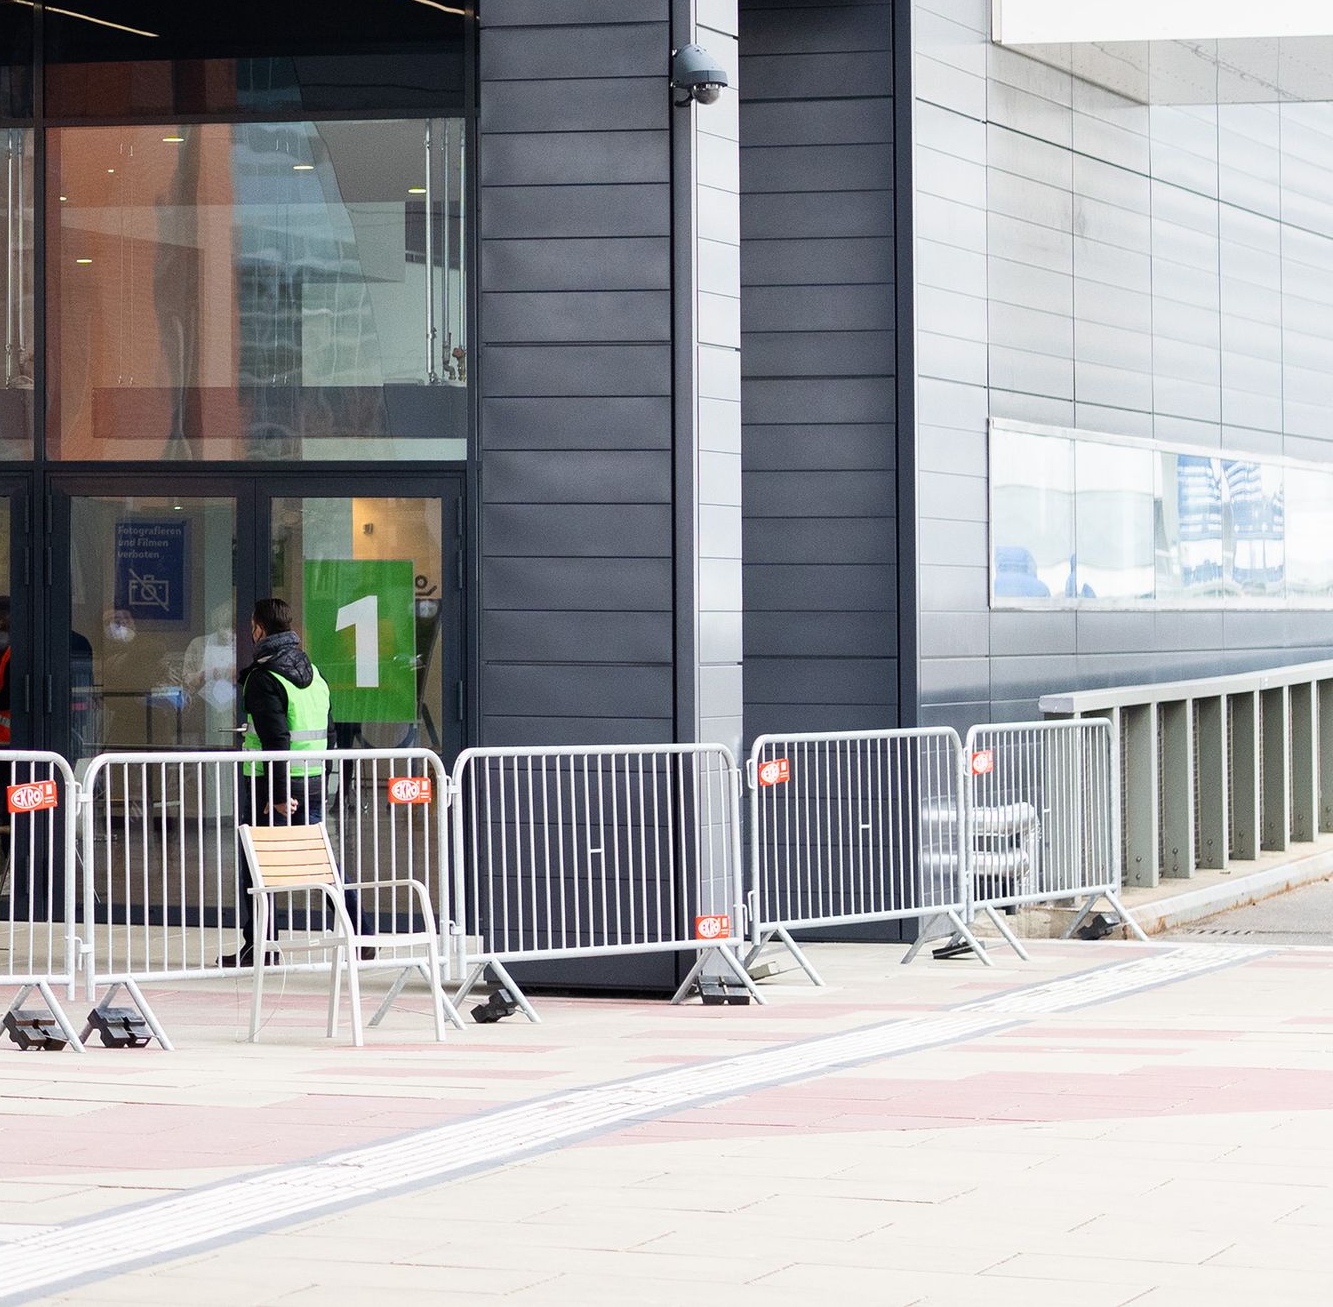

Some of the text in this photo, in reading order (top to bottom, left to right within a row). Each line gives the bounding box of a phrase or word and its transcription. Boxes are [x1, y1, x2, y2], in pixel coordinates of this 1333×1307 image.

[117, 525, 182, 537] Fotografieren
[118, 538, 169, 547] und Filmen
[117, 550, 160, 559] verboten
[335, 595, 380, 688] 1
[13, 788, 41, 807] EKRO
